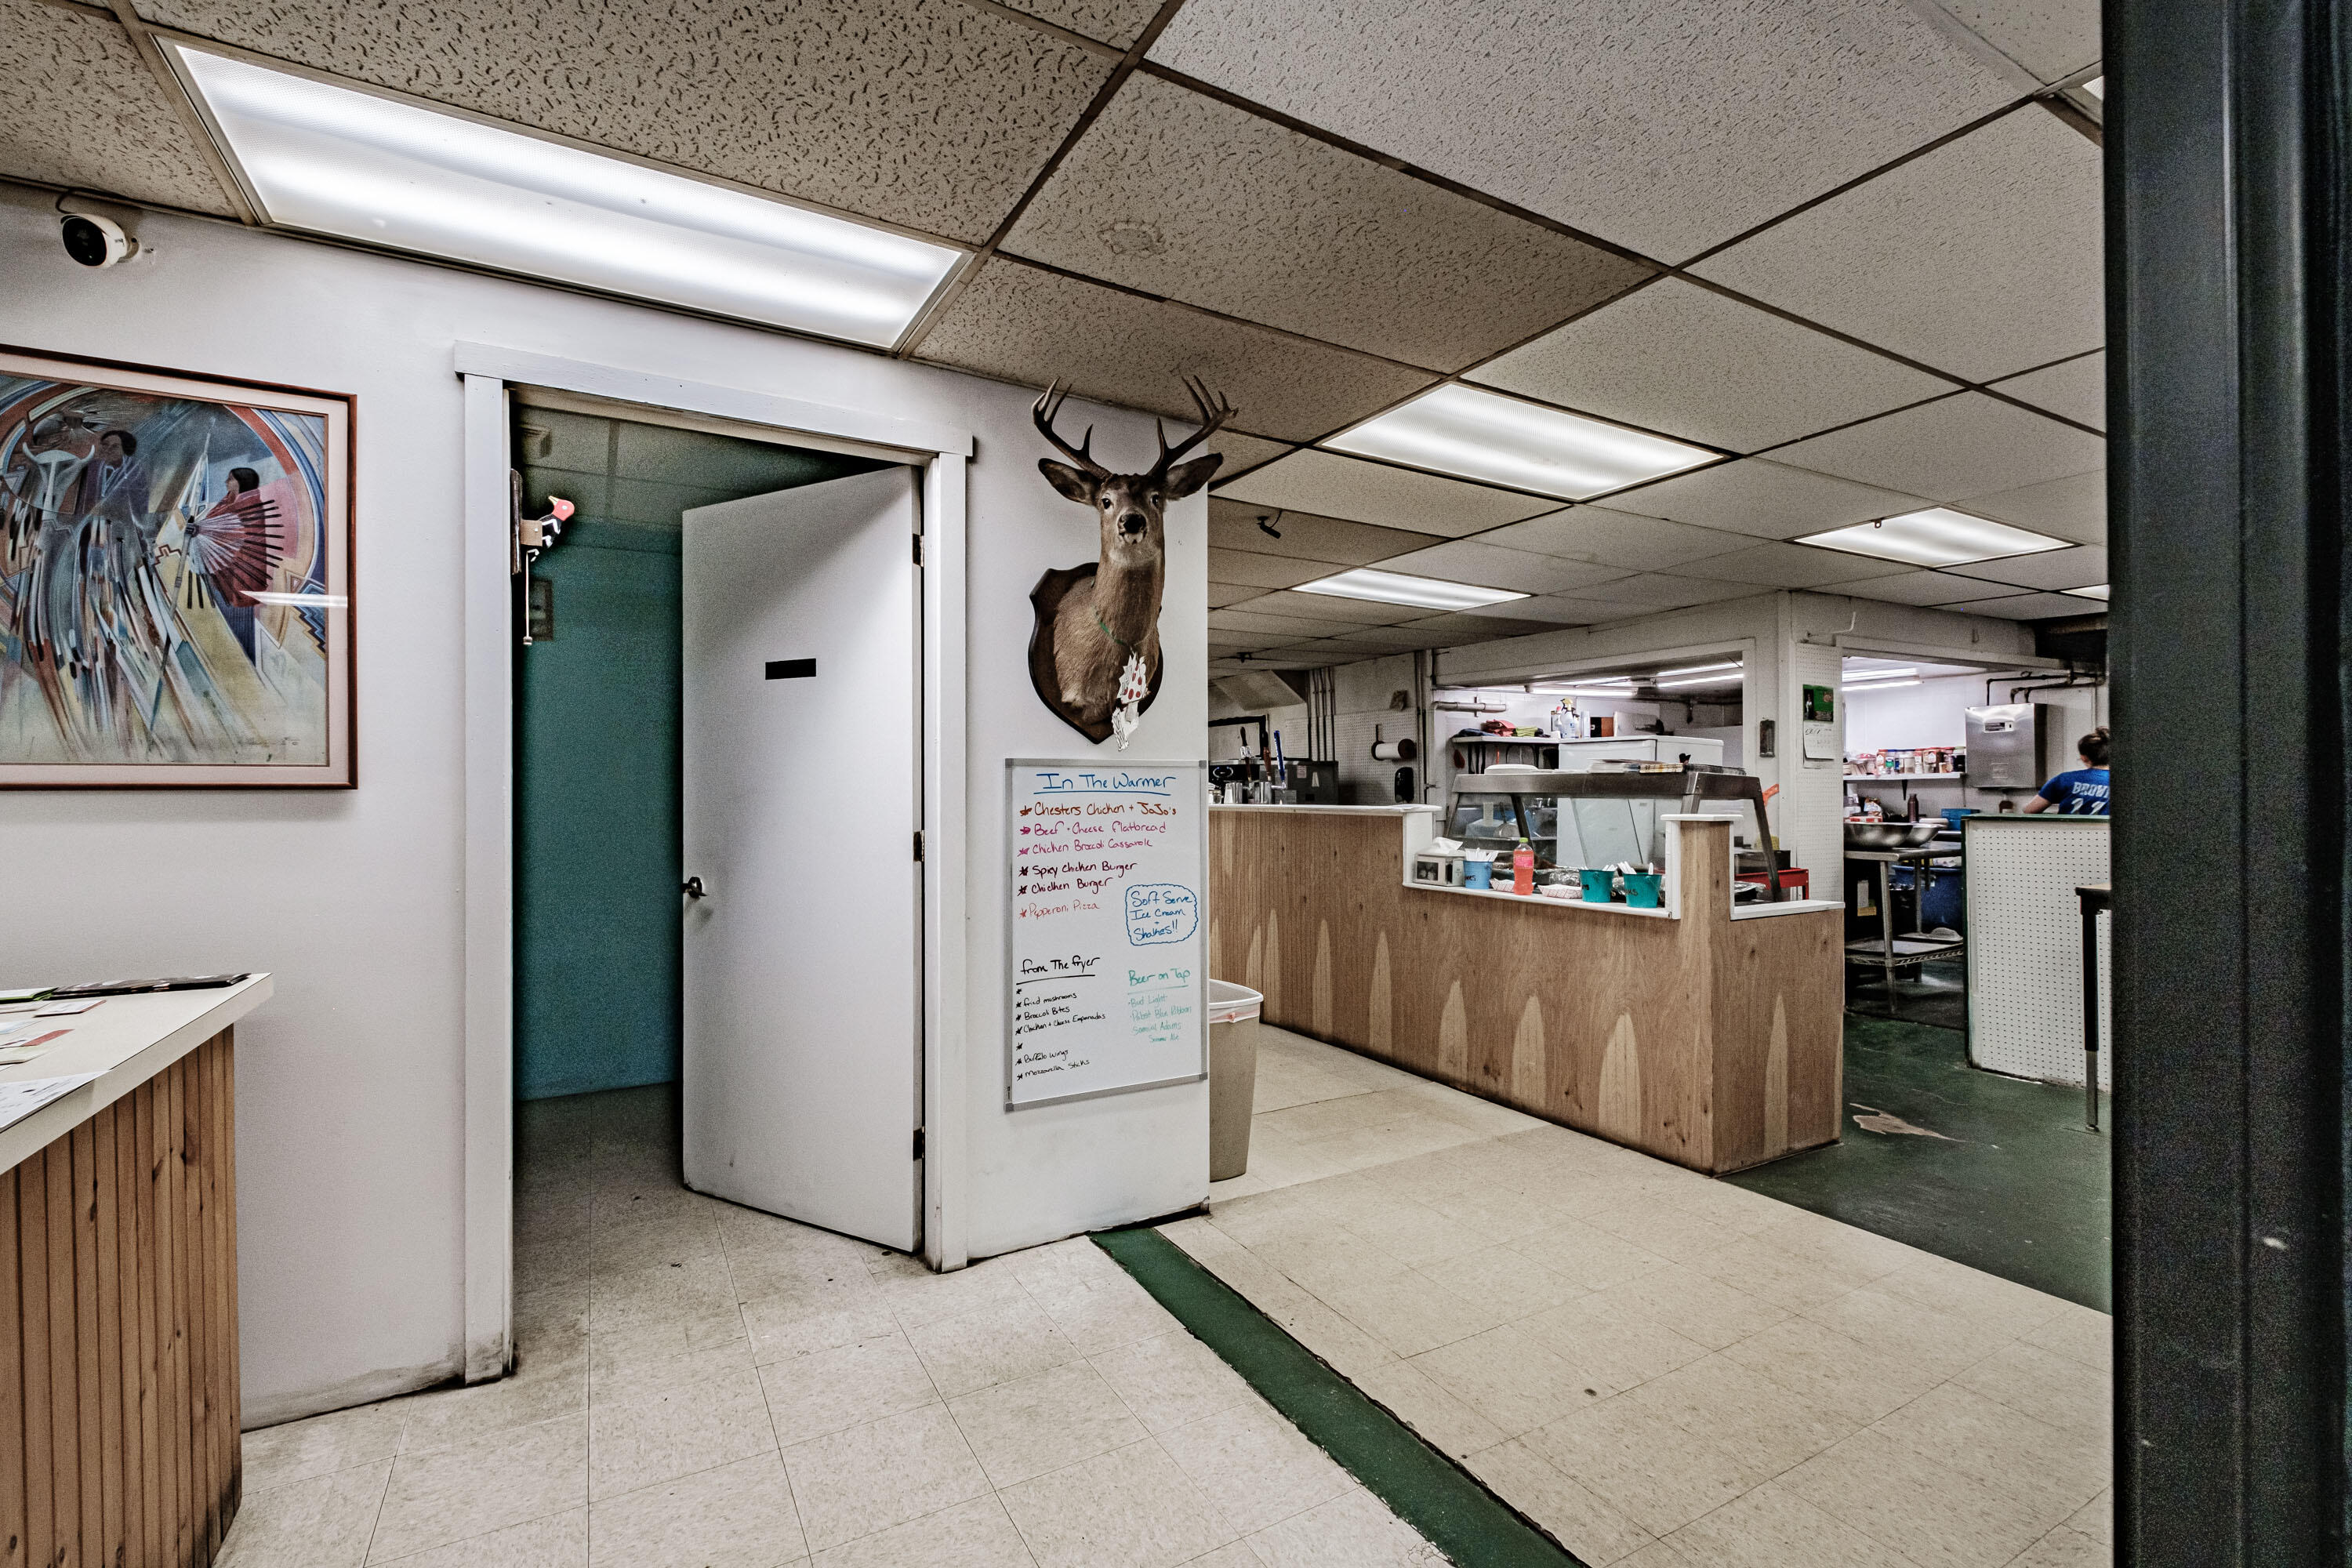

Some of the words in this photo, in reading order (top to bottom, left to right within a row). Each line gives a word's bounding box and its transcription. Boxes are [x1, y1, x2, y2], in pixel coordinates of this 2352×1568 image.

[1036, 773, 1073, 789] In
[1078, 774, 1108, 789] The
[1112, 772, 1176, 789] Warmer
[1034, 801, 1081, 816] Chesters
[1087, 802, 1125, 815] Chicken
[1137, 801, 1177, 815] JoJo's
[1034, 820, 1065, 836] Beef
[1072, 821, 1105, 834] Cheese
[1032, 842, 1069, 855] Chicken
[1032, 865, 1058, 879] Spicy
[1102, 861, 1138, 878] Burger
[1076, 877, 1113, 895] Burger
[1073, 899, 1101, 910] Pizza
[1131, 890, 1160, 907] Soft
[1162, 890, 1193, 905] Serve
[1129, 909, 1151, 920] Ice
[1154, 908, 1186, 917] Cream
[1050, 960, 1069, 970] The
[1128, 970, 1156, 986] Beer
[1170, 967, 1191, 983] Tap
[1051, 1006, 1070, 1015] Bites
